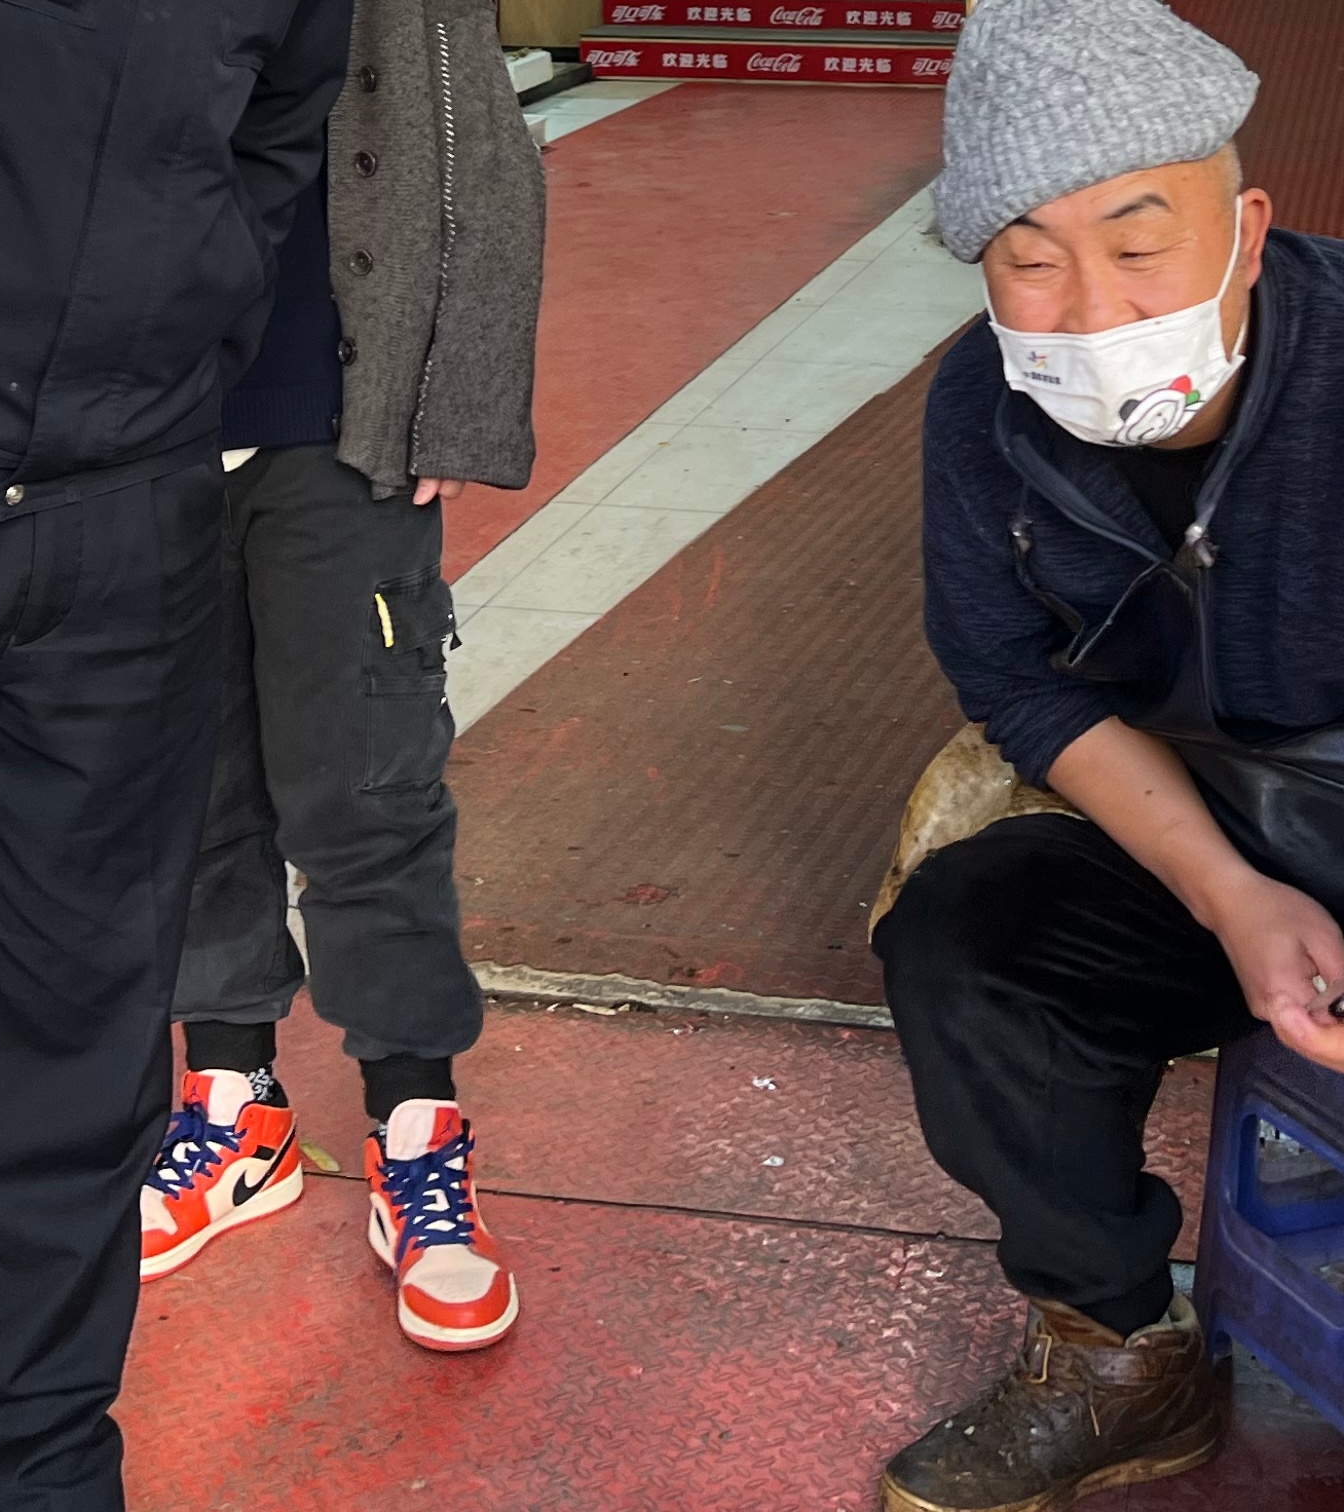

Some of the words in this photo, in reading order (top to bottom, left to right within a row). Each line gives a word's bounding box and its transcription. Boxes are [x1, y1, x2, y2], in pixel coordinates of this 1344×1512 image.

[687, 6, 752, 22] 欢迎光临
[846, 10, 912, 26] 欢迎光临
[662, 52, 728, 69] 欢迎光临
[824, 57, 892, 73] 欢迎光临
